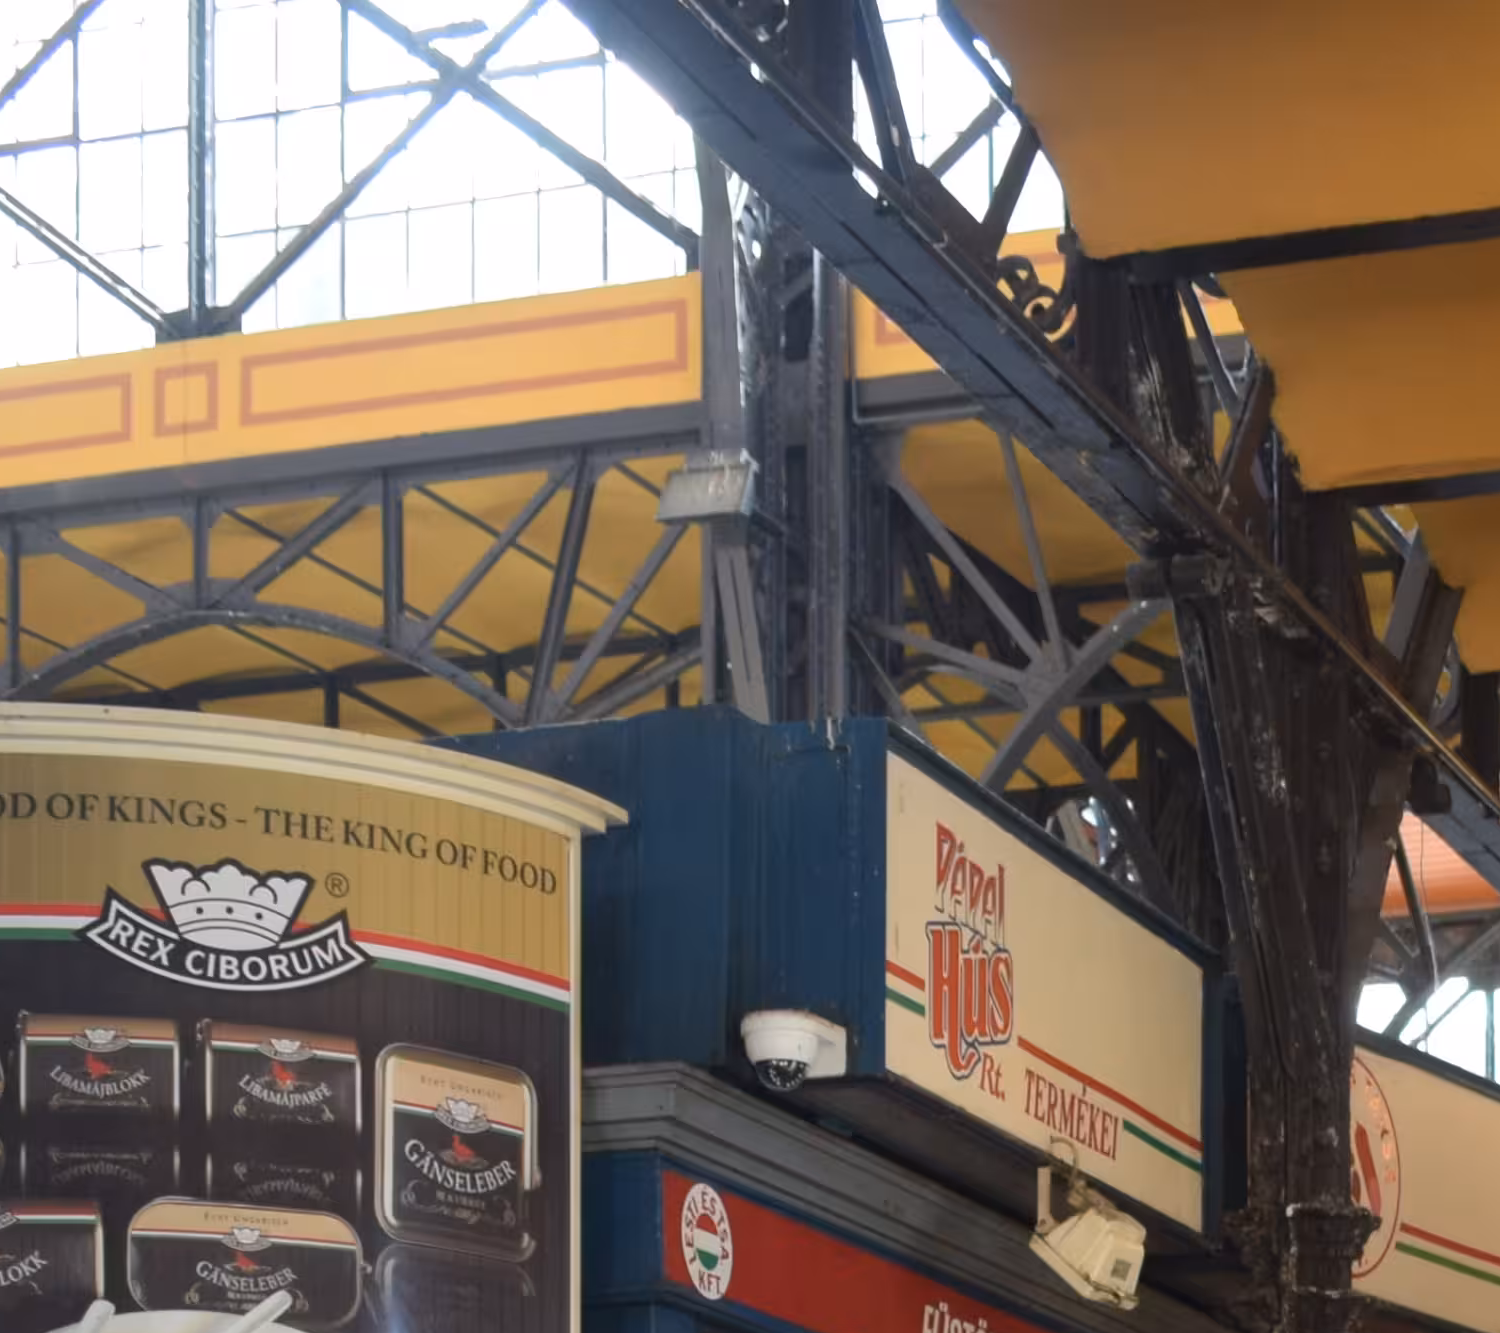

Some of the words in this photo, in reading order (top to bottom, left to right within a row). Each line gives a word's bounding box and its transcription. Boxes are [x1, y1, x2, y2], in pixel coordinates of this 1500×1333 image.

[45, 794, 101, 820] OF
[104, 795, 228, 831] KINGS
[254, 807, 335, 845] THE
[341, 822, 429, 861] KING
[433, 837, 482, 875] OF
[482, 848, 558, 896] FOOD
[108, 916, 172, 968] REX
[184, 934, 345, 982] CIBORUM
[926, 921, 1014, 1080] Hús
[50, 1063, 150, 1099] LIBAMÁJBLOKK
[979, 1052, 1006, 1101] Rt.
[1023, 1068, 1120, 1161] TERMÉKEI
[404, 1139, 516, 1194] GÄNSELEBER
[196, 1262, 298, 1294] GÄNSELEBER
